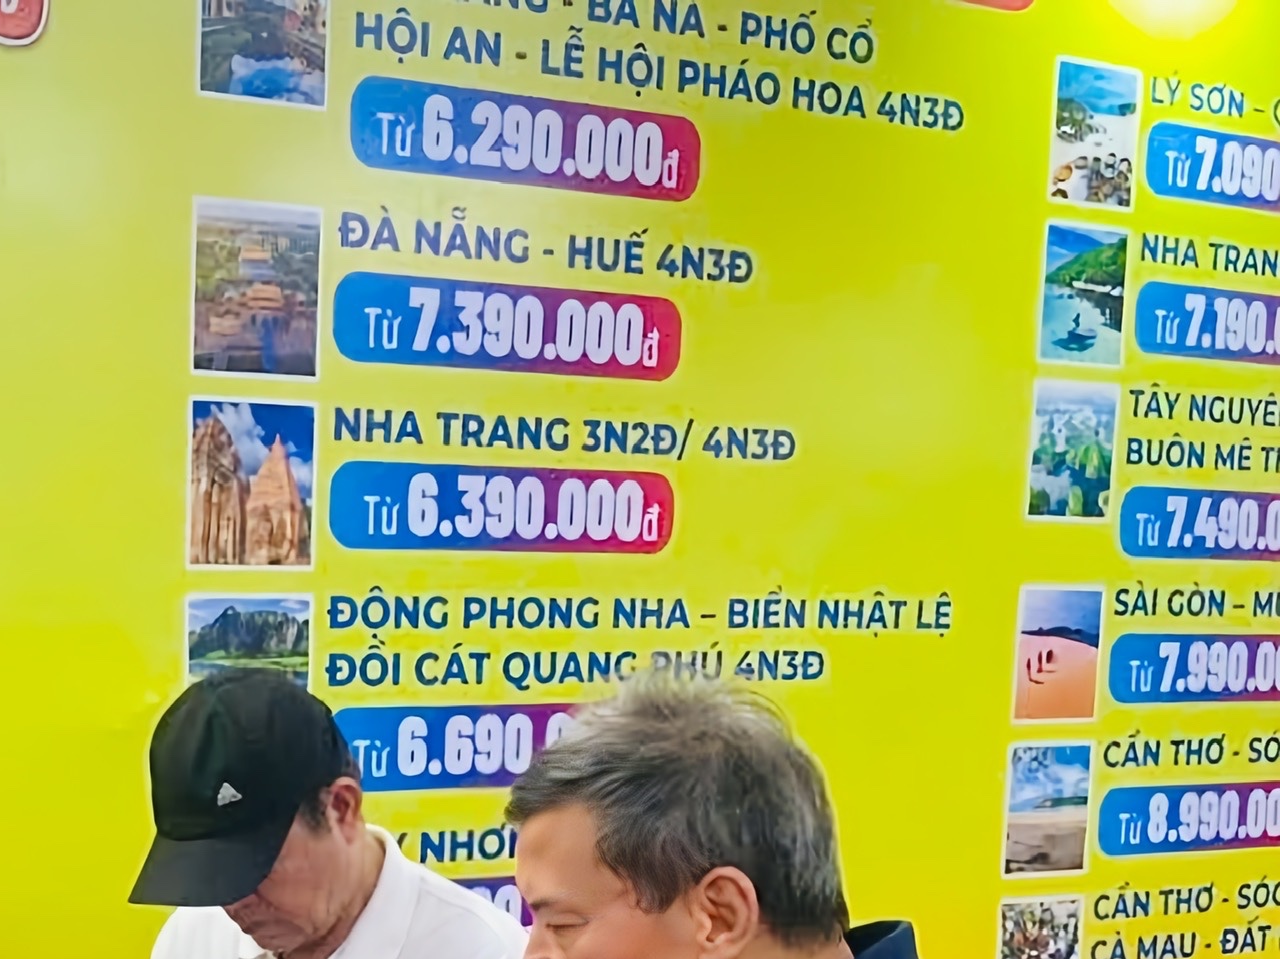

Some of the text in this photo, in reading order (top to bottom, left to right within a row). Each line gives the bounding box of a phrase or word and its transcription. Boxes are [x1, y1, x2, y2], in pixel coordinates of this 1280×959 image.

[740, 11, 817, 54] PHỐ
[827, 19, 874, 64] CỔ
[356, 10, 430, 64] HỘI
[444, 27, 501, 66] AN
[541, 26, 585, 78] LỄ
[599, 43, 665, 98] HỘI
[679, 59, 780, 105] PHÁO
[792, 79, 865, 118] HOA
[877, 94, 964, 131] 4N3Đ
[1151, 70, 1181, 106] LÝ
[1190, 83, 1245, 118] SƠN
[376, 94, 680, 189] Từ 6.290.000đ
[339, 208, 401, 253] ĐÀ
[415, 207, 529, 264] NẴNG
[568, 227, 649, 275] HUẾ
[657, 246, 754, 284] 4N3Đ
[1141, 232, 1199, 269] NHA
[365, 287, 660, 368] Từ 7.390.000đ
[1129, 382, 1280, 427] TÂY NGUYÊ
[334, 406, 796, 461] NHA TRANG 3N2Đ/ 4N3Đ
[1126, 433, 1205, 469] BUÔN
[1215, 437, 1252, 473] MÊ
[363, 471, 662, 543] Từ 6.390.000đ
[1136, 513, 1161, 547] Từ
[327, 586, 449, 639] ĐỘNG
[463, 597, 599, 630] PHONG
[612, 597, 691, 630] NHA
[728, 584, 807, 629] BIỂN
[818, 591, 908, 638] NHẬT
[916, 591, 952, 638] LỆ
[1114, 580, 1159, 617] SÀI
[1167, 581, 1226, 617] GÒN
[1252, 590, 1280, 617] M
[325, 638, 401, 687] ĐỒI
[414, 642, 491, 686] CÁT
[503, 650, 638, 691] QUANG
[734, 650, 825, 681] 4N3Đ
[1159, 640, 1280, 694] 7.990.0
[353, 738, 390, 782] Từ
[1170, 734, 1226, 766] THƠ
[1158, 881, 1215, 916] THƠ
[1219, 916, 1272, 954] ĐẤT
